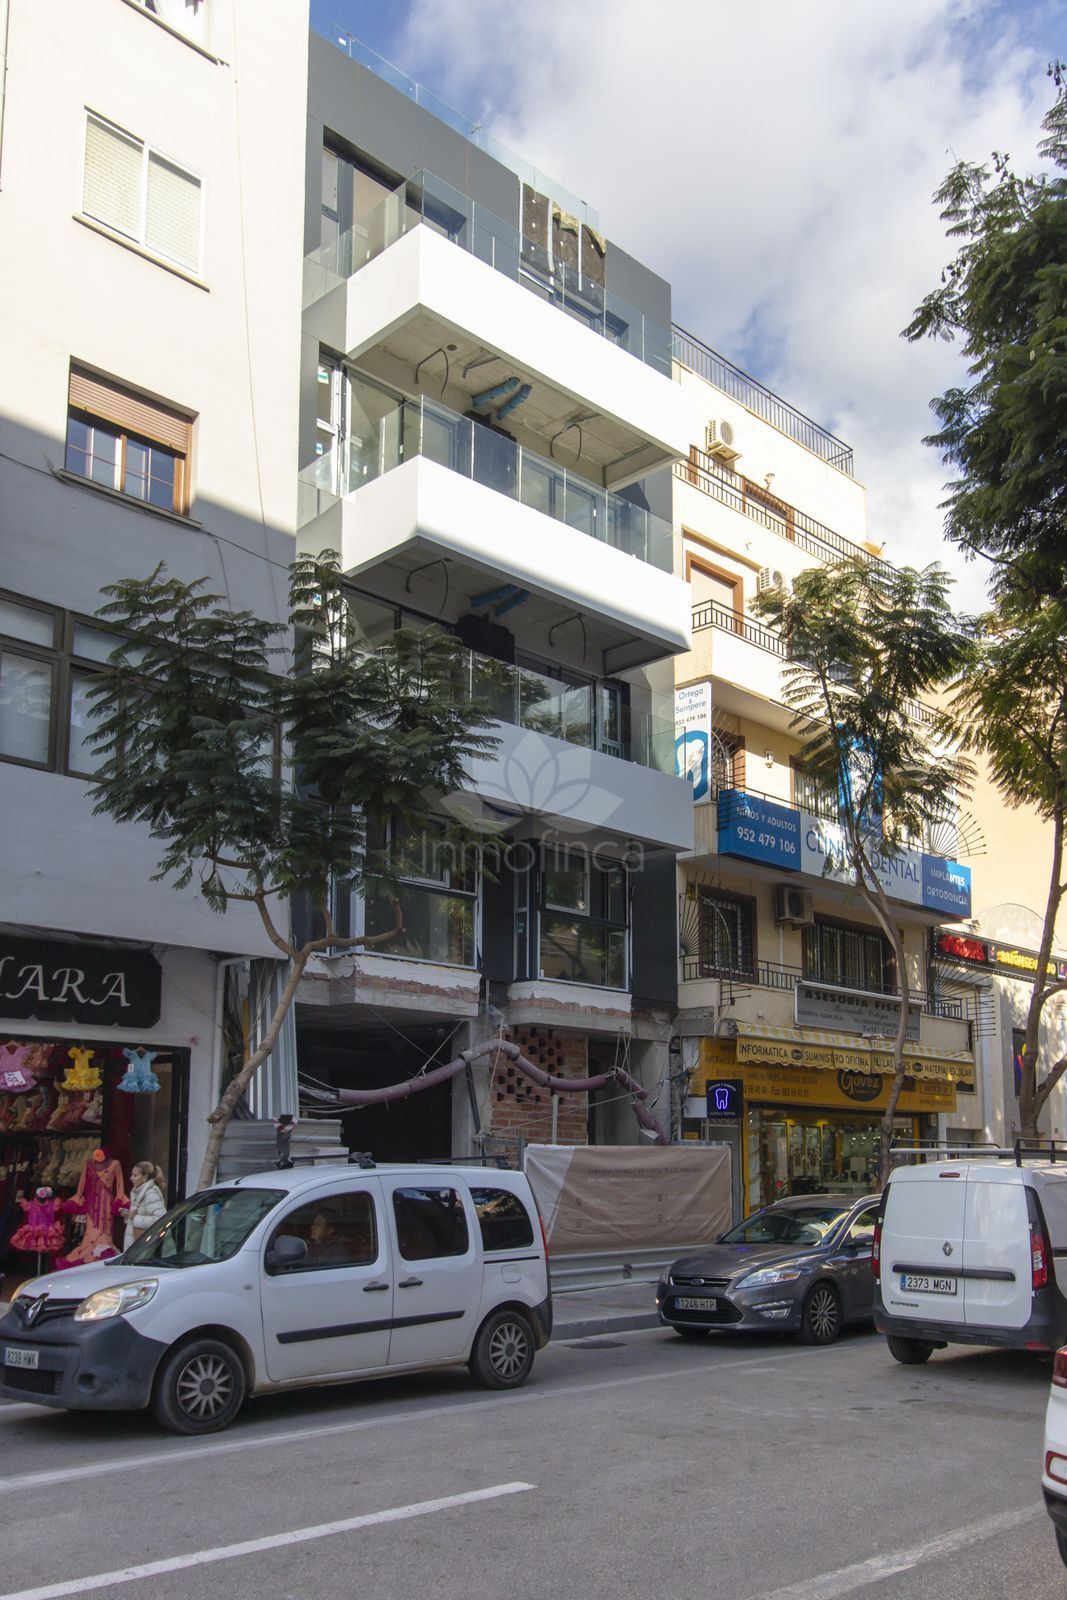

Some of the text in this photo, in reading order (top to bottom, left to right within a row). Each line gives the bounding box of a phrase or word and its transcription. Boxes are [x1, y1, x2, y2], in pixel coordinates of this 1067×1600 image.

[678, 688, 704, 700] Ortega
[675, 700, 707, 714] Sempere
[761, 815, 766, 823] Y
[767, 817, 797, 833] ADULTOS
[737, 826, 796, 855] 952 479 106
[870, 850, 920, 883] DENTAL
[930, 867, 965, 887] IMPLANTES
[926, 885, 968, 906] ORTODONCIA
[804, 990, 868, 1008] ASESORIA
[739, 1044, 789, 1059] INFORMATICA
[907, 1277, 952, 1291] 2373 MGN
